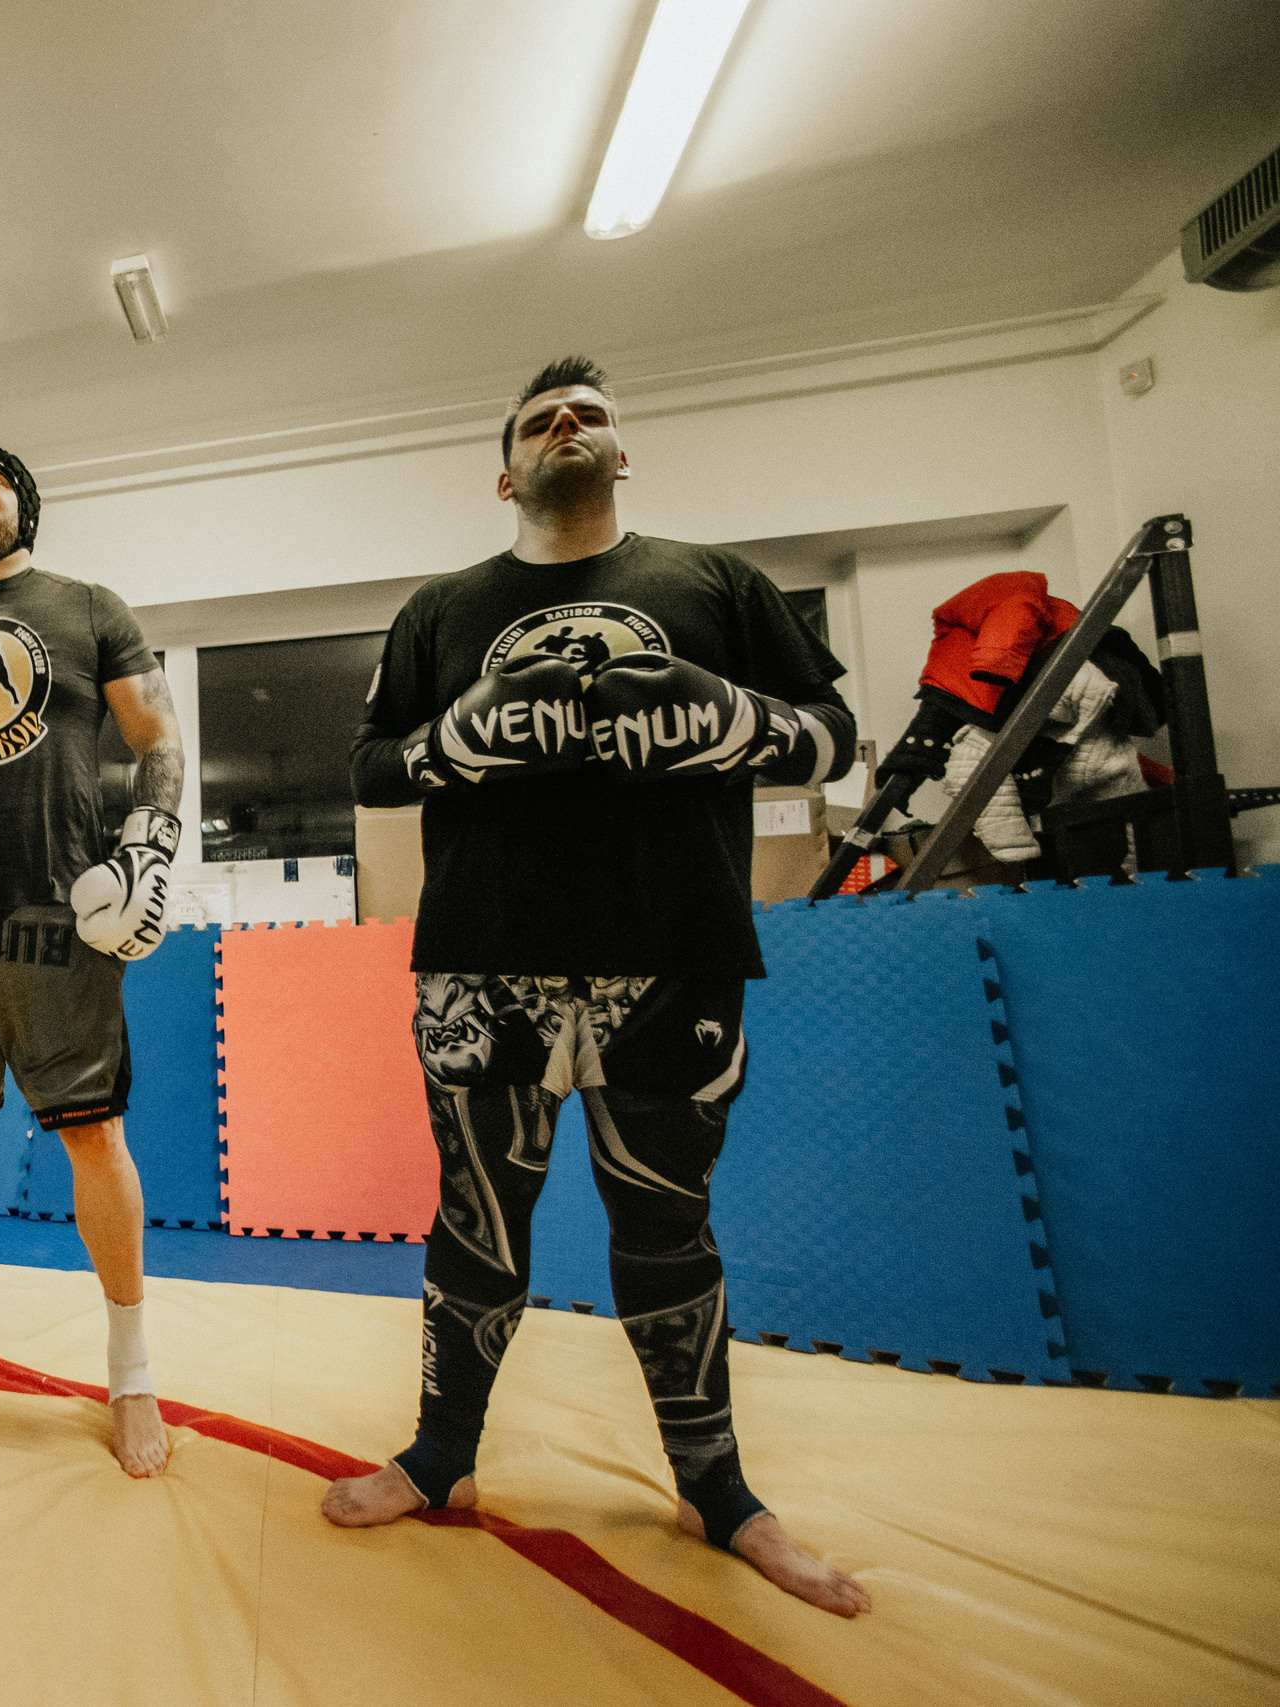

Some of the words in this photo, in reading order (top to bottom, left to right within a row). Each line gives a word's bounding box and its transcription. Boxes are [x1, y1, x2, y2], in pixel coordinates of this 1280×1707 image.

[545, 607, 603, 622] RATIBOR
[14, 626, 39, 650] FIGHT
[496, 628, 525, 655] KLUBI
[624, 615, 661, 645] FIGHT
[470, 699, 587, 755] VENU
[590, 700, 719, 771] ENUM
[109, 873, 168, 957] ENUM
